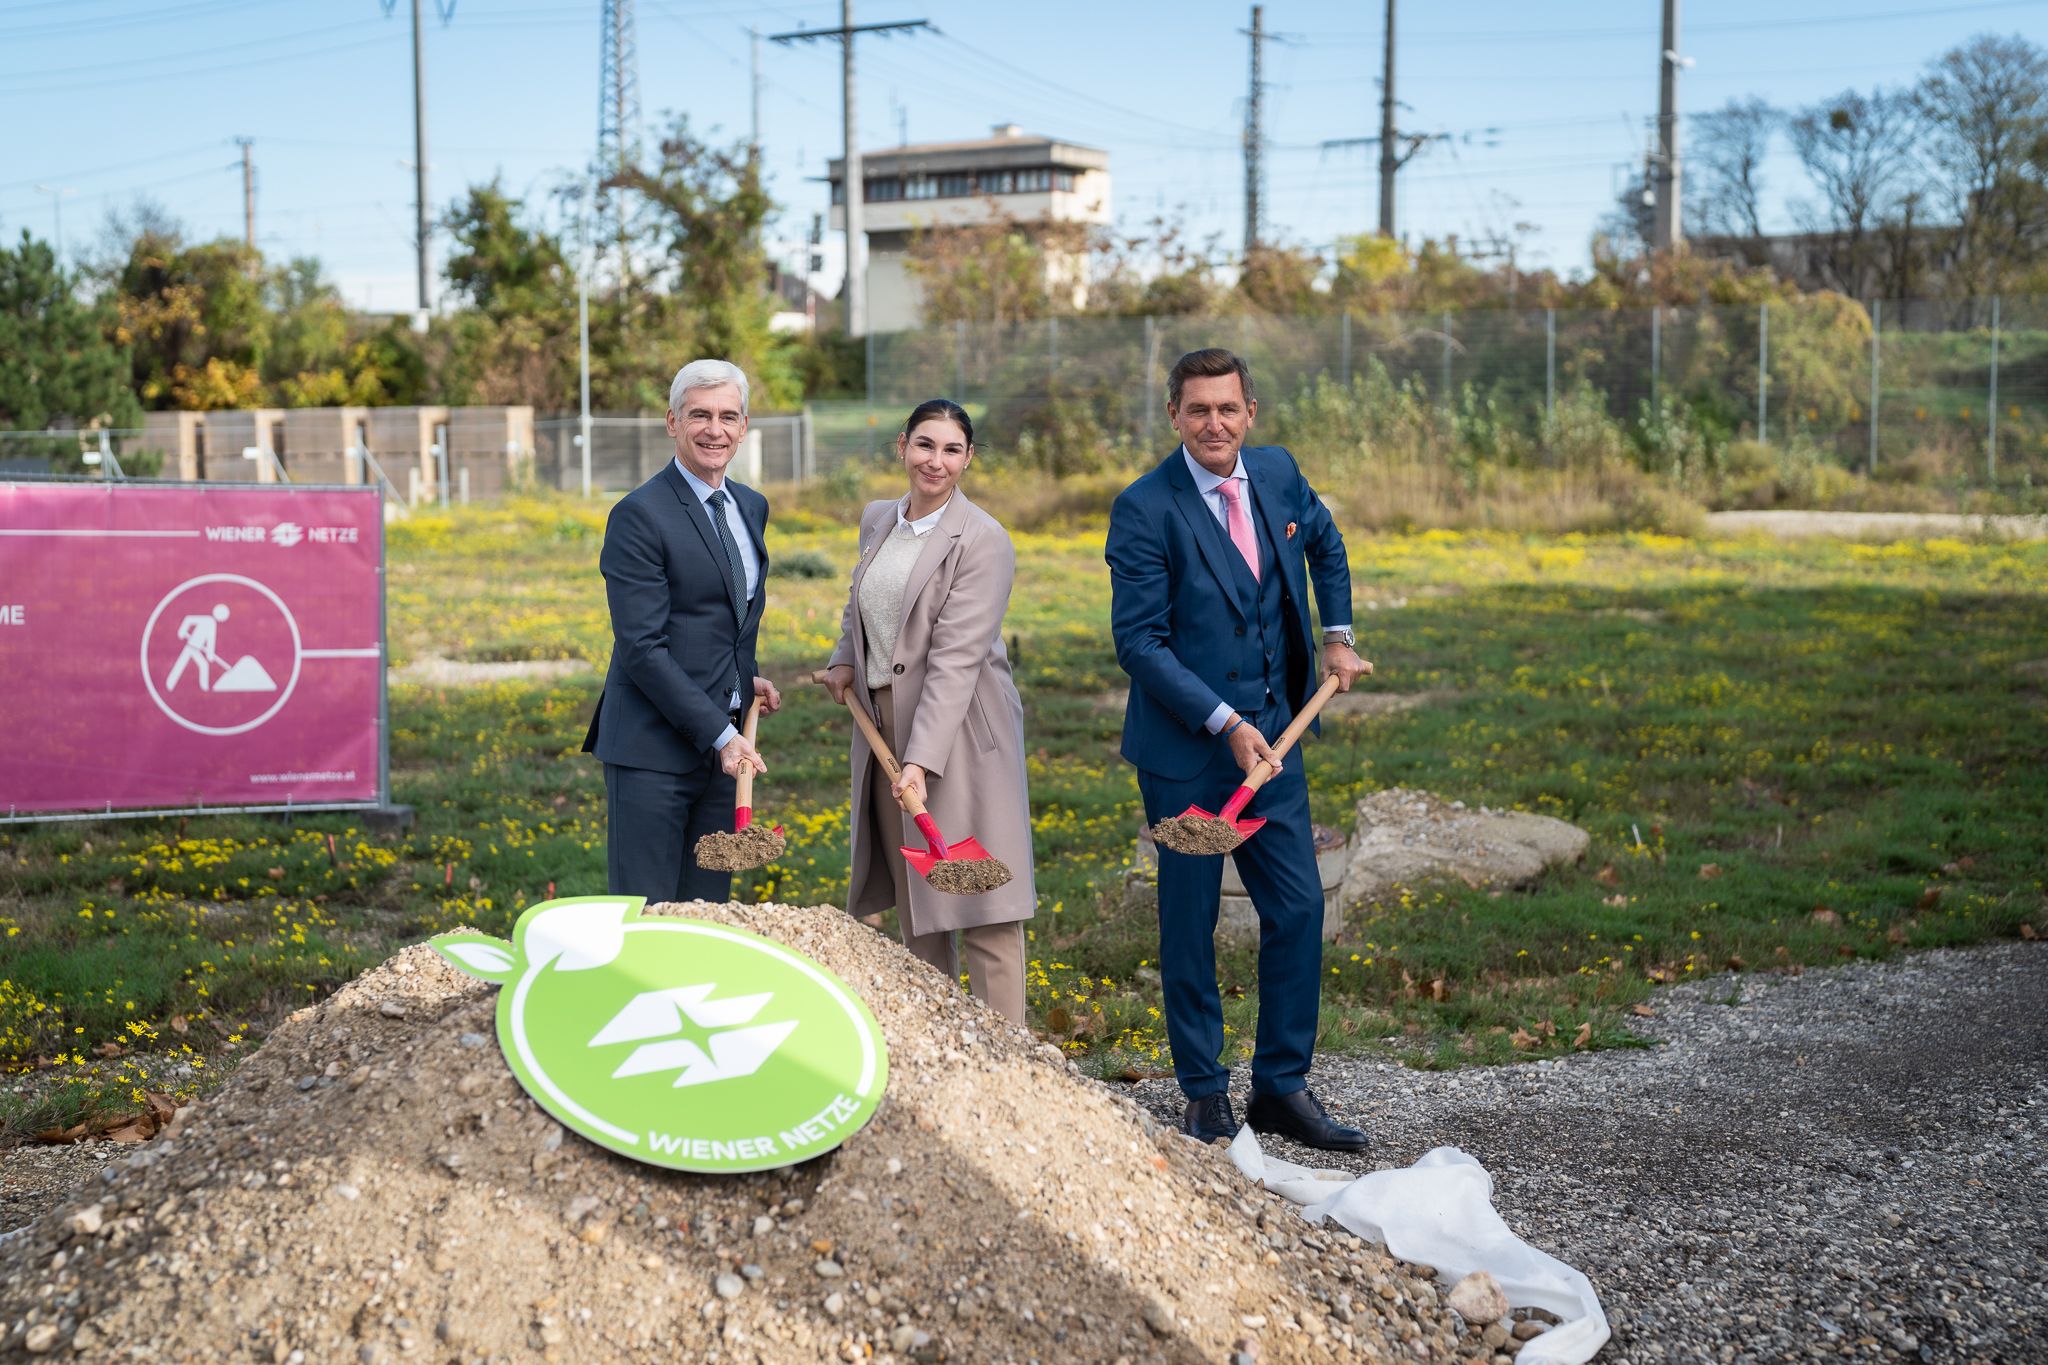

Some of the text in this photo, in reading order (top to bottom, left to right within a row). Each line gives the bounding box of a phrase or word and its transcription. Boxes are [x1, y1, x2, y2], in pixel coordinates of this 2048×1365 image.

[205, 526, 359, 543] WIENER NETZE
[648, 1092, 862, 1161] WIENER NETZE
